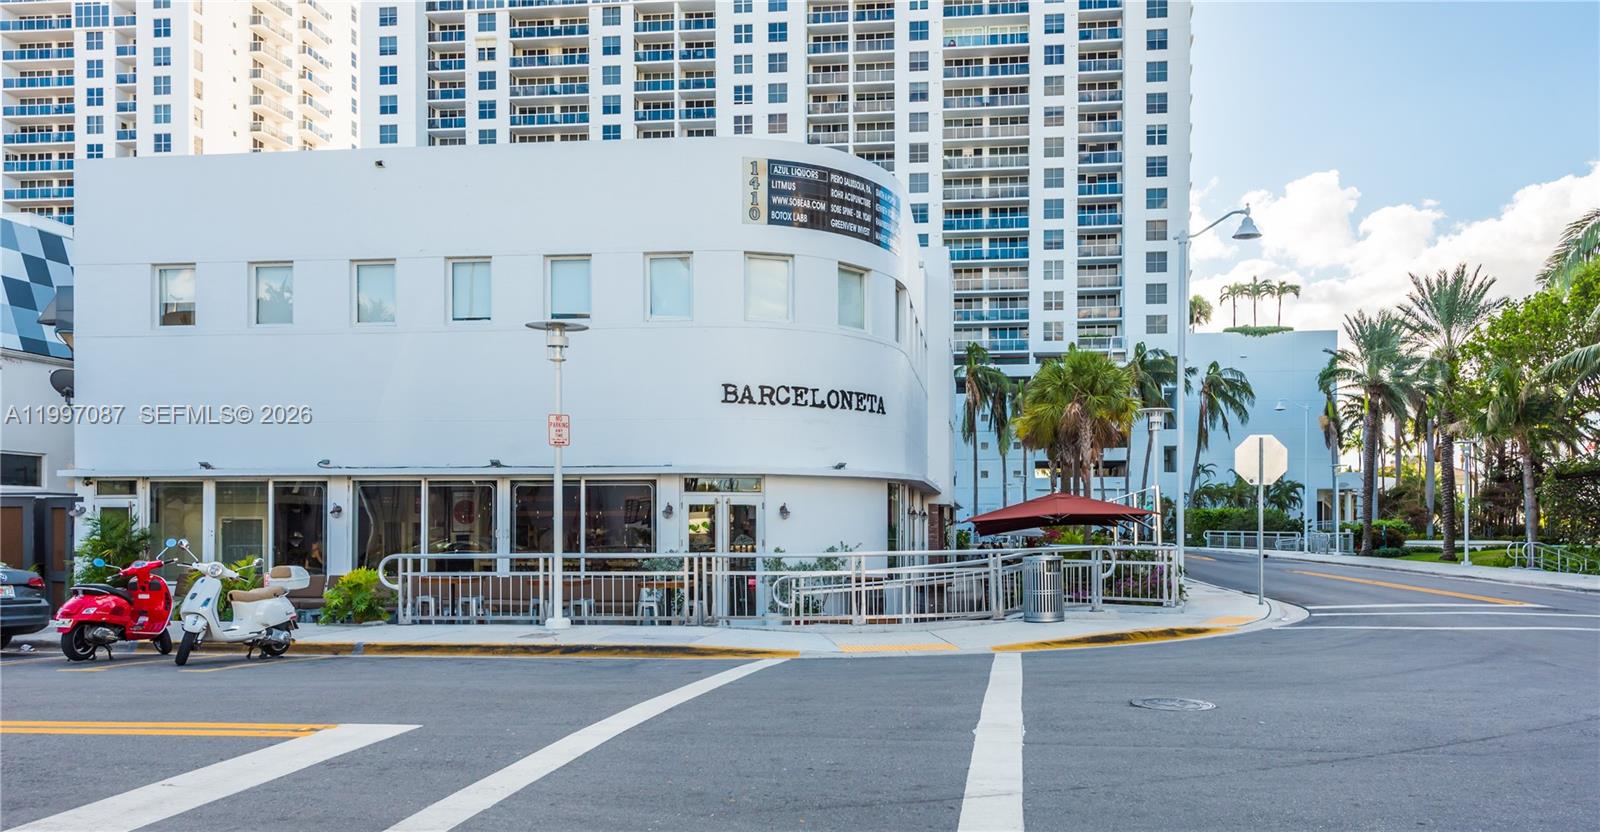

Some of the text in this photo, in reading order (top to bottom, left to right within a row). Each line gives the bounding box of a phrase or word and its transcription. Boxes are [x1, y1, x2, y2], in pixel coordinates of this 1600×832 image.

[773, 165, 819, 179] AZUL LIQUORS
[749, 161, 760, 221] 1410
[771, 180, 797, 191] LITMUS
[844, 192, 871, 208] ACUPUNCTURE
[771, 210, 792, 221] BOTOX
[842, 206, 854, 217] SPINE
[830, 218, 857, 232] GREENVIEW
[721, 383, 887, 415] BARCELONETA
